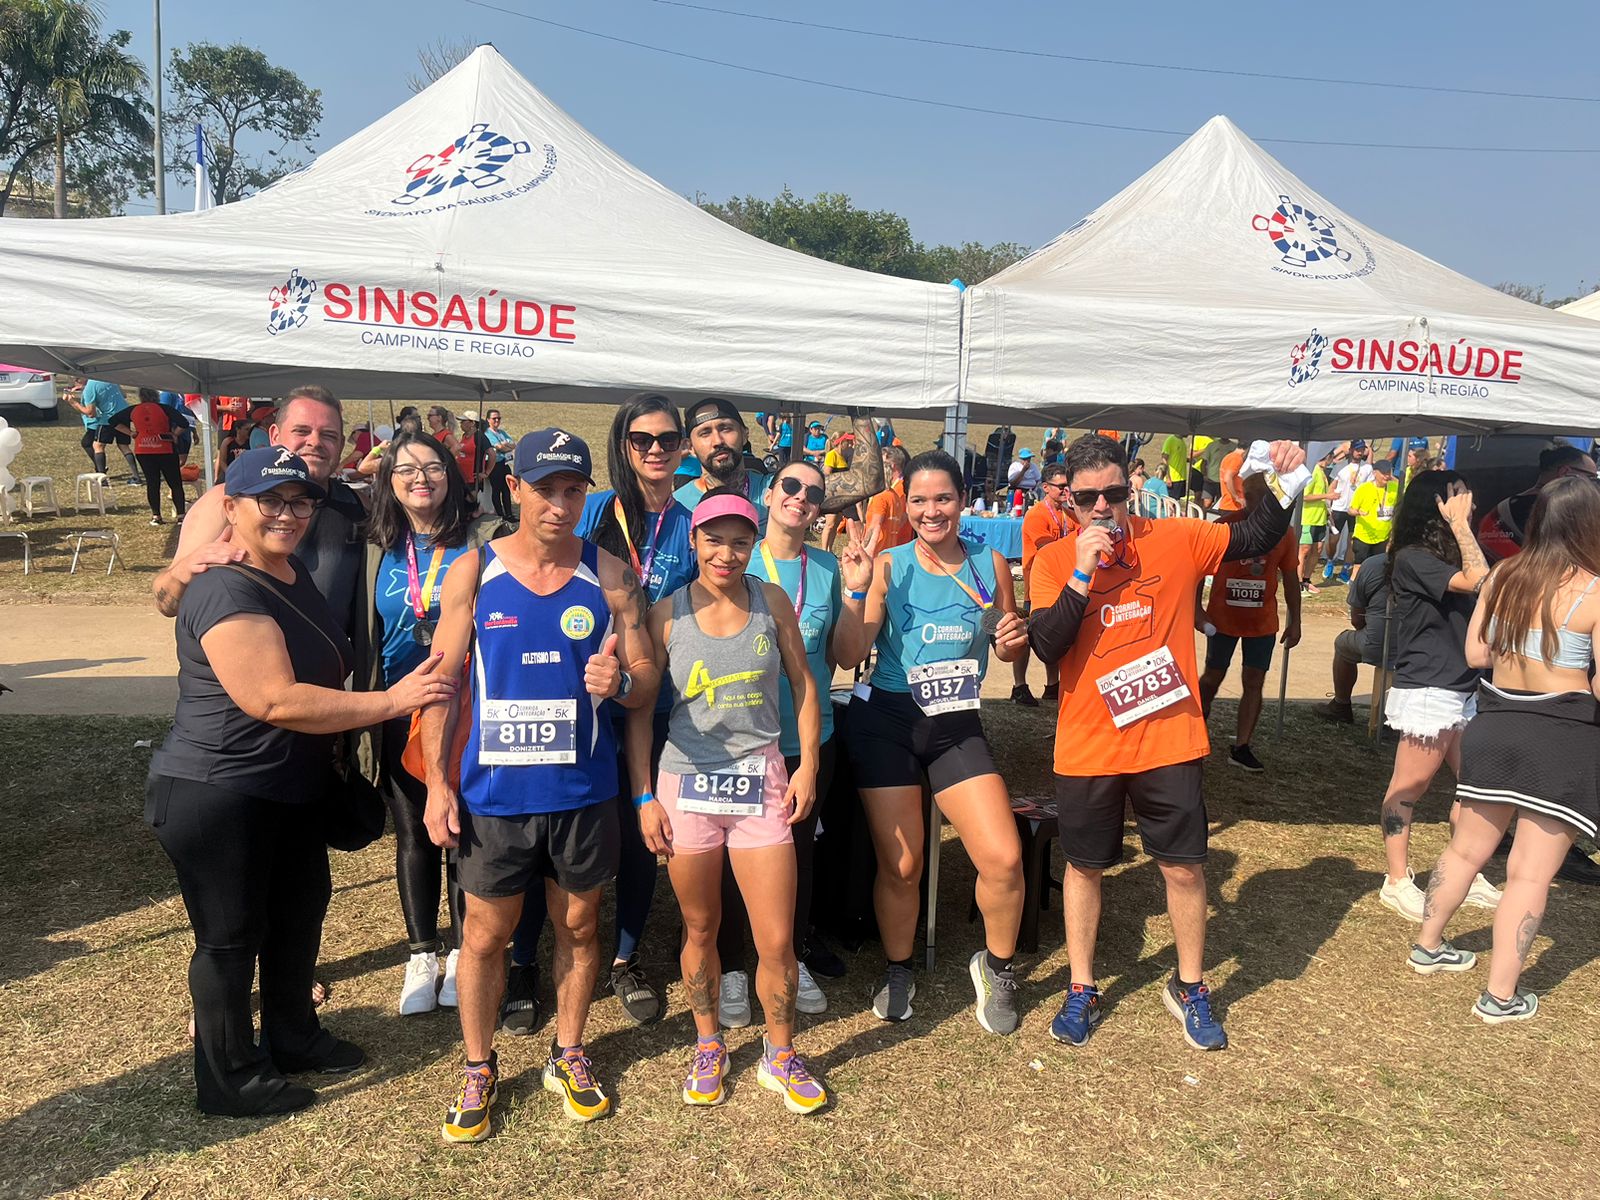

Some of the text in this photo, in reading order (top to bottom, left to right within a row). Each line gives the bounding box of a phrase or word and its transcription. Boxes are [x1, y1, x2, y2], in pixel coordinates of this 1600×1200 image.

[366, 143, 558, 217] SINDICATO DA SAÚDE DE CAMPINAS E REGIÃO
[1271, 266, 1338, 280] SINDICATO
[323, 283, 577, 340] SINSAÚDE
[361, 330, 535, 358] CAMPINAS E REGIÃO
[1330, 337, 1523, 381] SINSAÚDE
[1358, 379, 1426, 394] CAMPINAS
[1440, 383, 1489, 399] REGIÃO
[1231, 588, 1260, 598] 11018
[1115, 600, 1140, 614] CORRIDA
[1115, 606, 1152, 622] INTEGRAÇÃO
[522, 651, 550, 664] ATLETISMO
[1152, 655, 1168, 666] 10K
[910, 673, 920, 682] 5K
[1100, 679, 1114, 690] 10K
[920, 678, 964, 700] 8137
[1109, 667, 1172, 706] 12783
[1137, 694, 1158, 706] DANIEL
[487, 709, 500, 718] 5K
[554, 708, 568, 718] 5K
[499, 721, 556, 744] 8119
[747, 764, 760, 774] 5K
[693, 773, 750, 796] 8149
[626, 990, 652, 1002] PUMA
[505, 999, 534, 1012] PUMA
